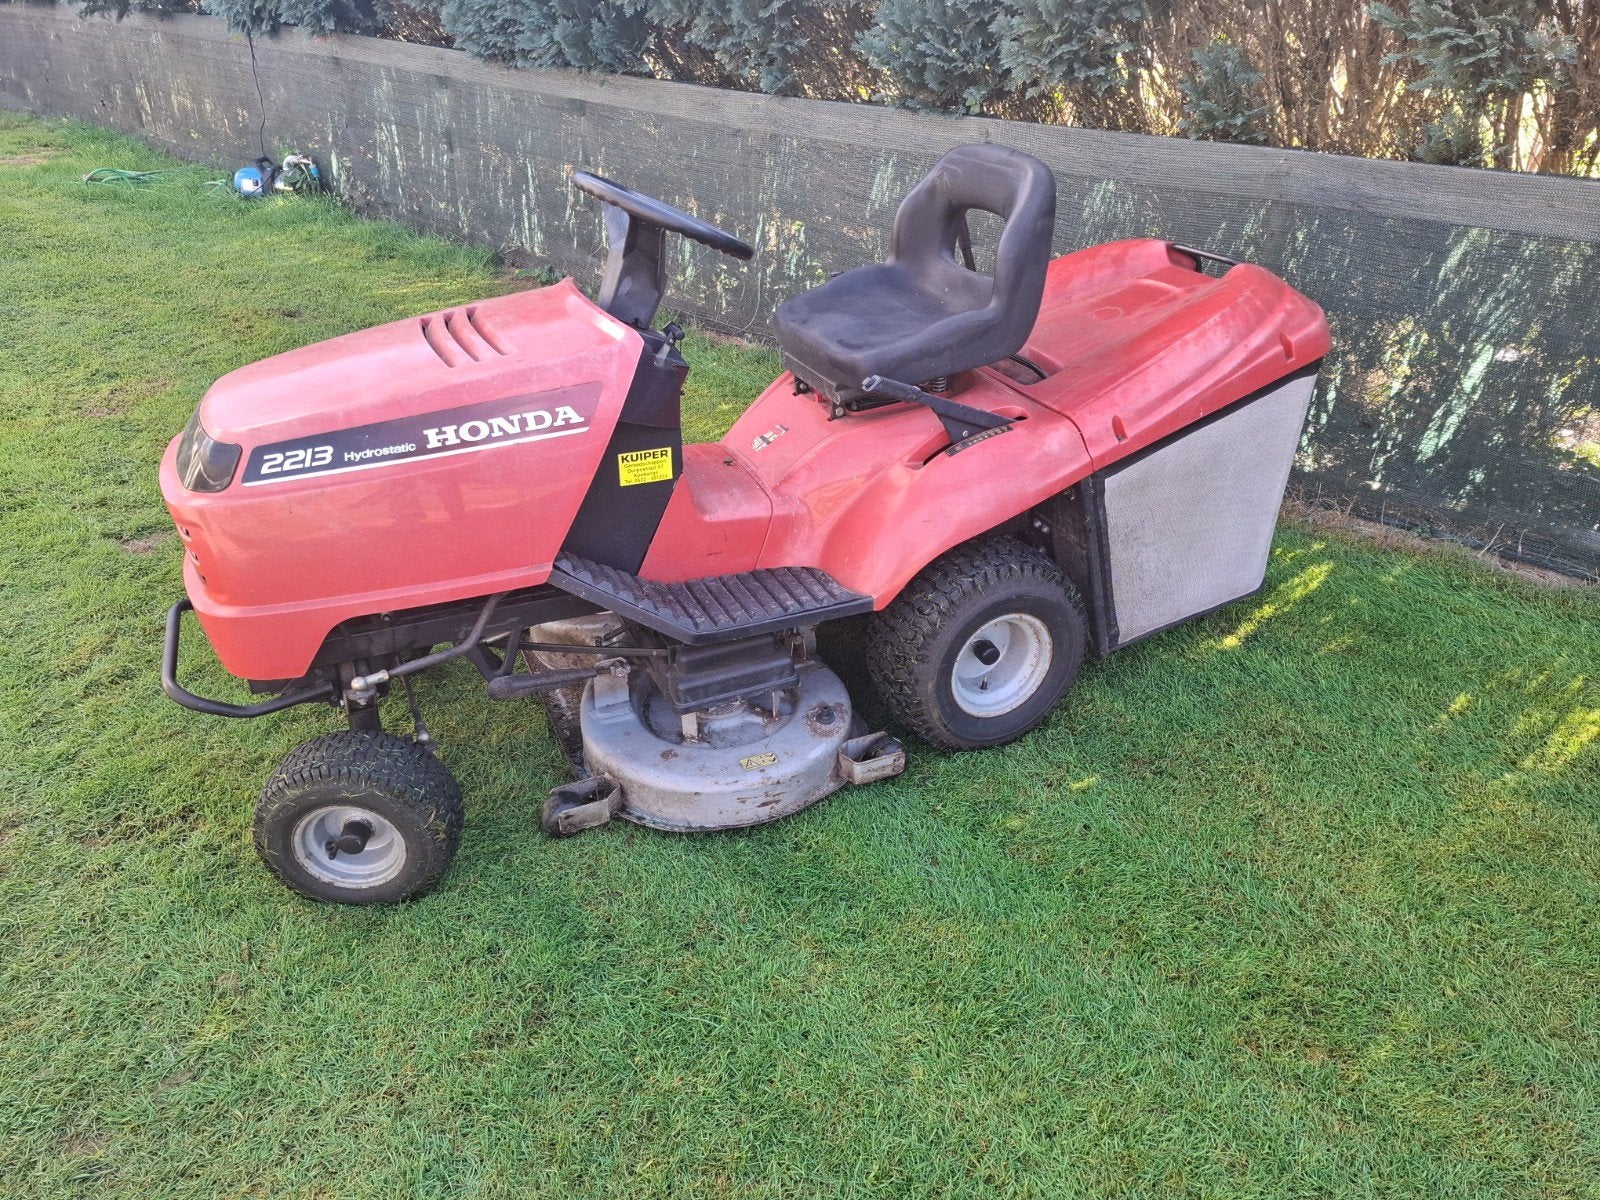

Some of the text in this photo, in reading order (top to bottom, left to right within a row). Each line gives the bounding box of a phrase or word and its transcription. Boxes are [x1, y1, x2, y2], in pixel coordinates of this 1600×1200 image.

[260, 405, 585, 475] 2213 Hydrostatic HONDA
[621, 450, 668, 463] KUIPER
[624, 459, 667, 468] Gereedschappen
